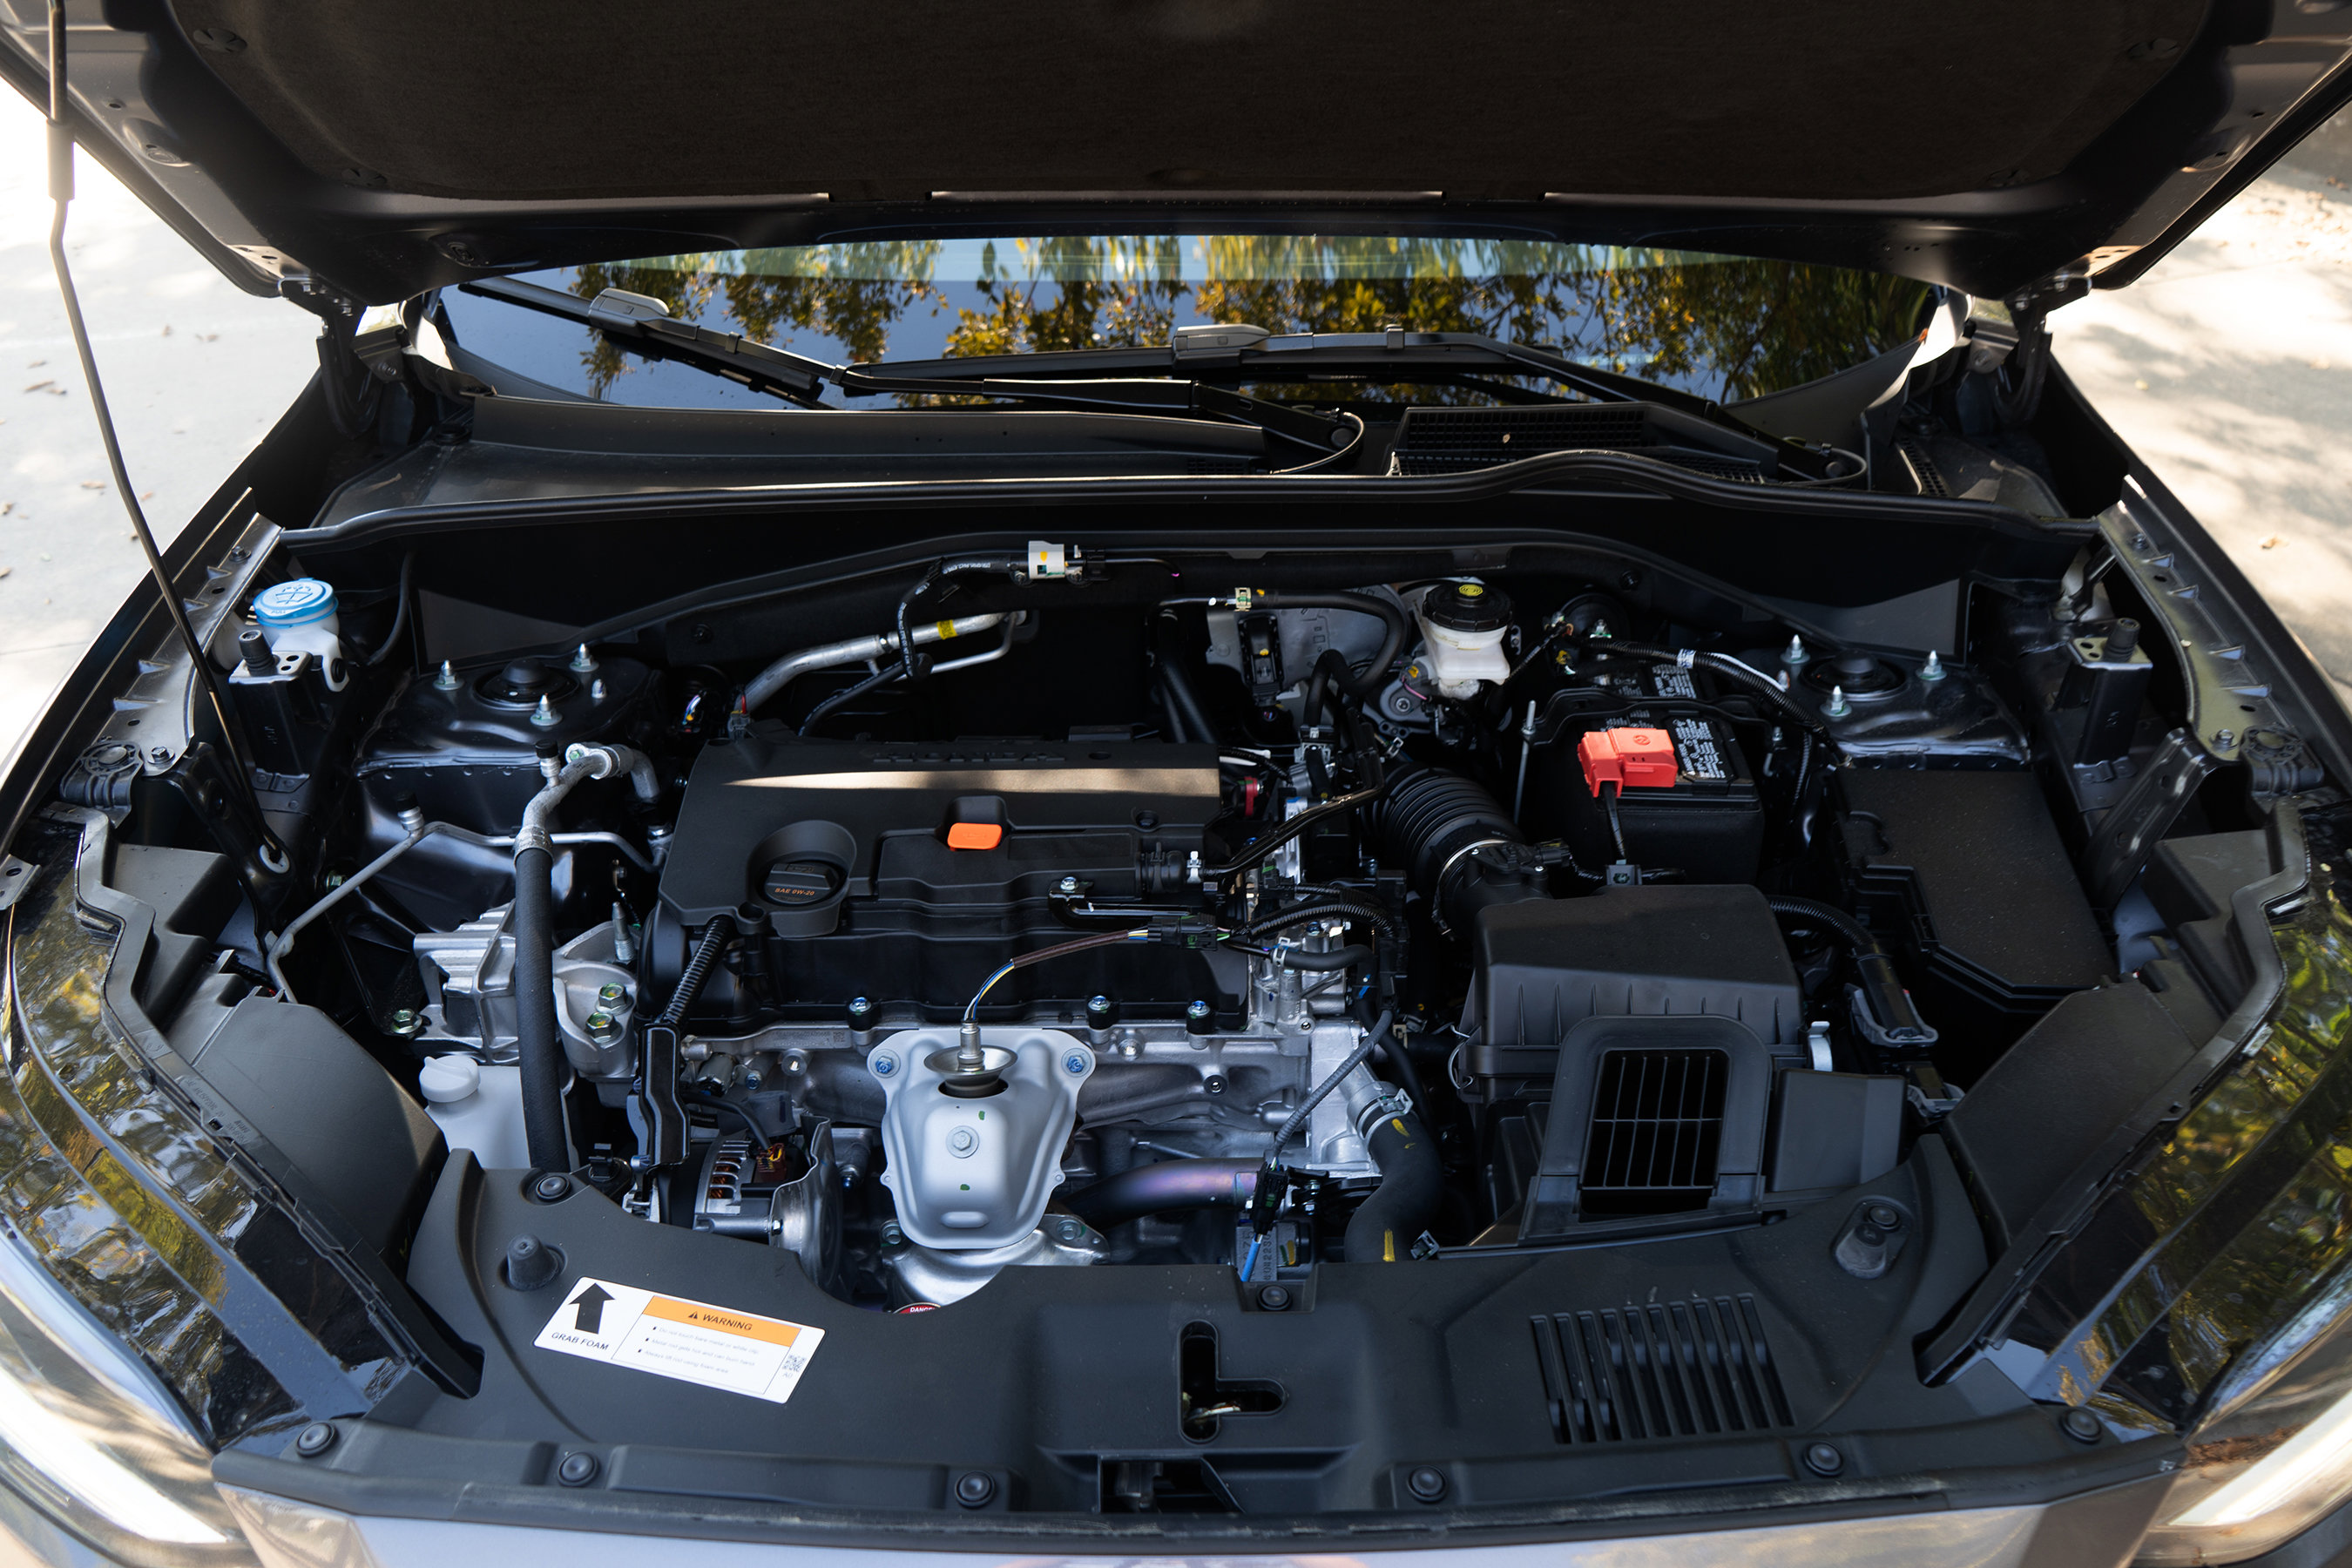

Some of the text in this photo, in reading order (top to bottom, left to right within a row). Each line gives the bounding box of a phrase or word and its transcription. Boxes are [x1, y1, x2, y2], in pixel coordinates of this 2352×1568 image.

[703, 1314, 753, 1331] WARNING
[551, 1332, 609, 1350] GRAB FOAM
